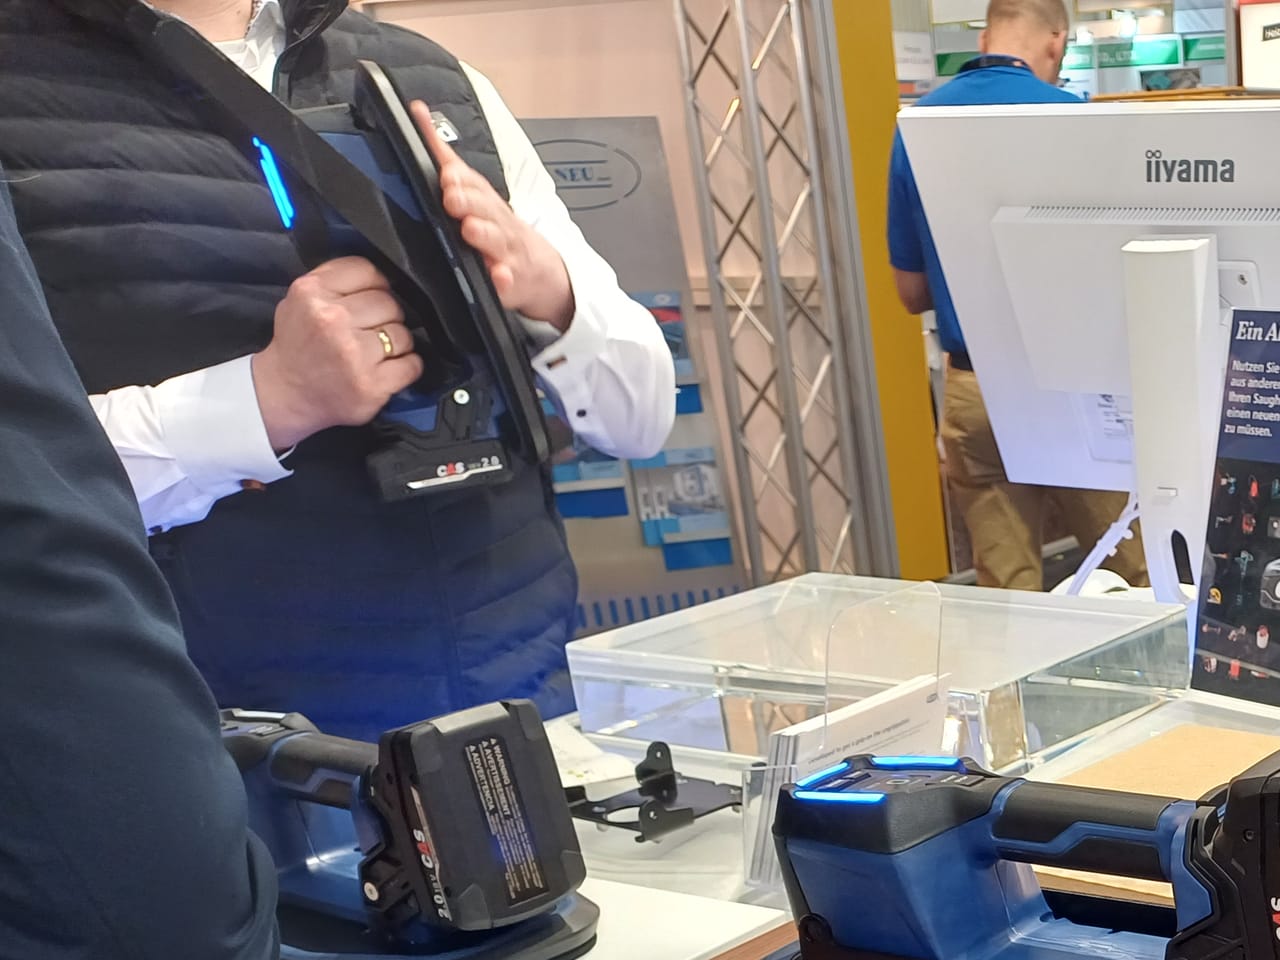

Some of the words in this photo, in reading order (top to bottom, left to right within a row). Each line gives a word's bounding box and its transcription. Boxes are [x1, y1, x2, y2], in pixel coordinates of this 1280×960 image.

[1145, 149, 1235, 183] iiyama
[1235, 321, 1263, 341] Ein
[1232, 359, 1264, 374] Nutzen
[1266, 361, 1280, 374] Sie
[1230, 377, 1246, 388] aus
[1228, 391, 1252, 404] Ihren
[1226, 408, 1251, 420] einen
[1252, 410, 1280, 422] neuen
[1224, 424, 1235, 434] zu
[1236, 424, 1273, 437] müssen.
[437, 462, 465, 477] CAS
[493, 744, 511, 785] WARNING
[472, 752, 495, 811] ADVERTENCIA
[484, 748, 511, 816] AVERTISSEMENT
[413, 829, 434, 869] CAS
